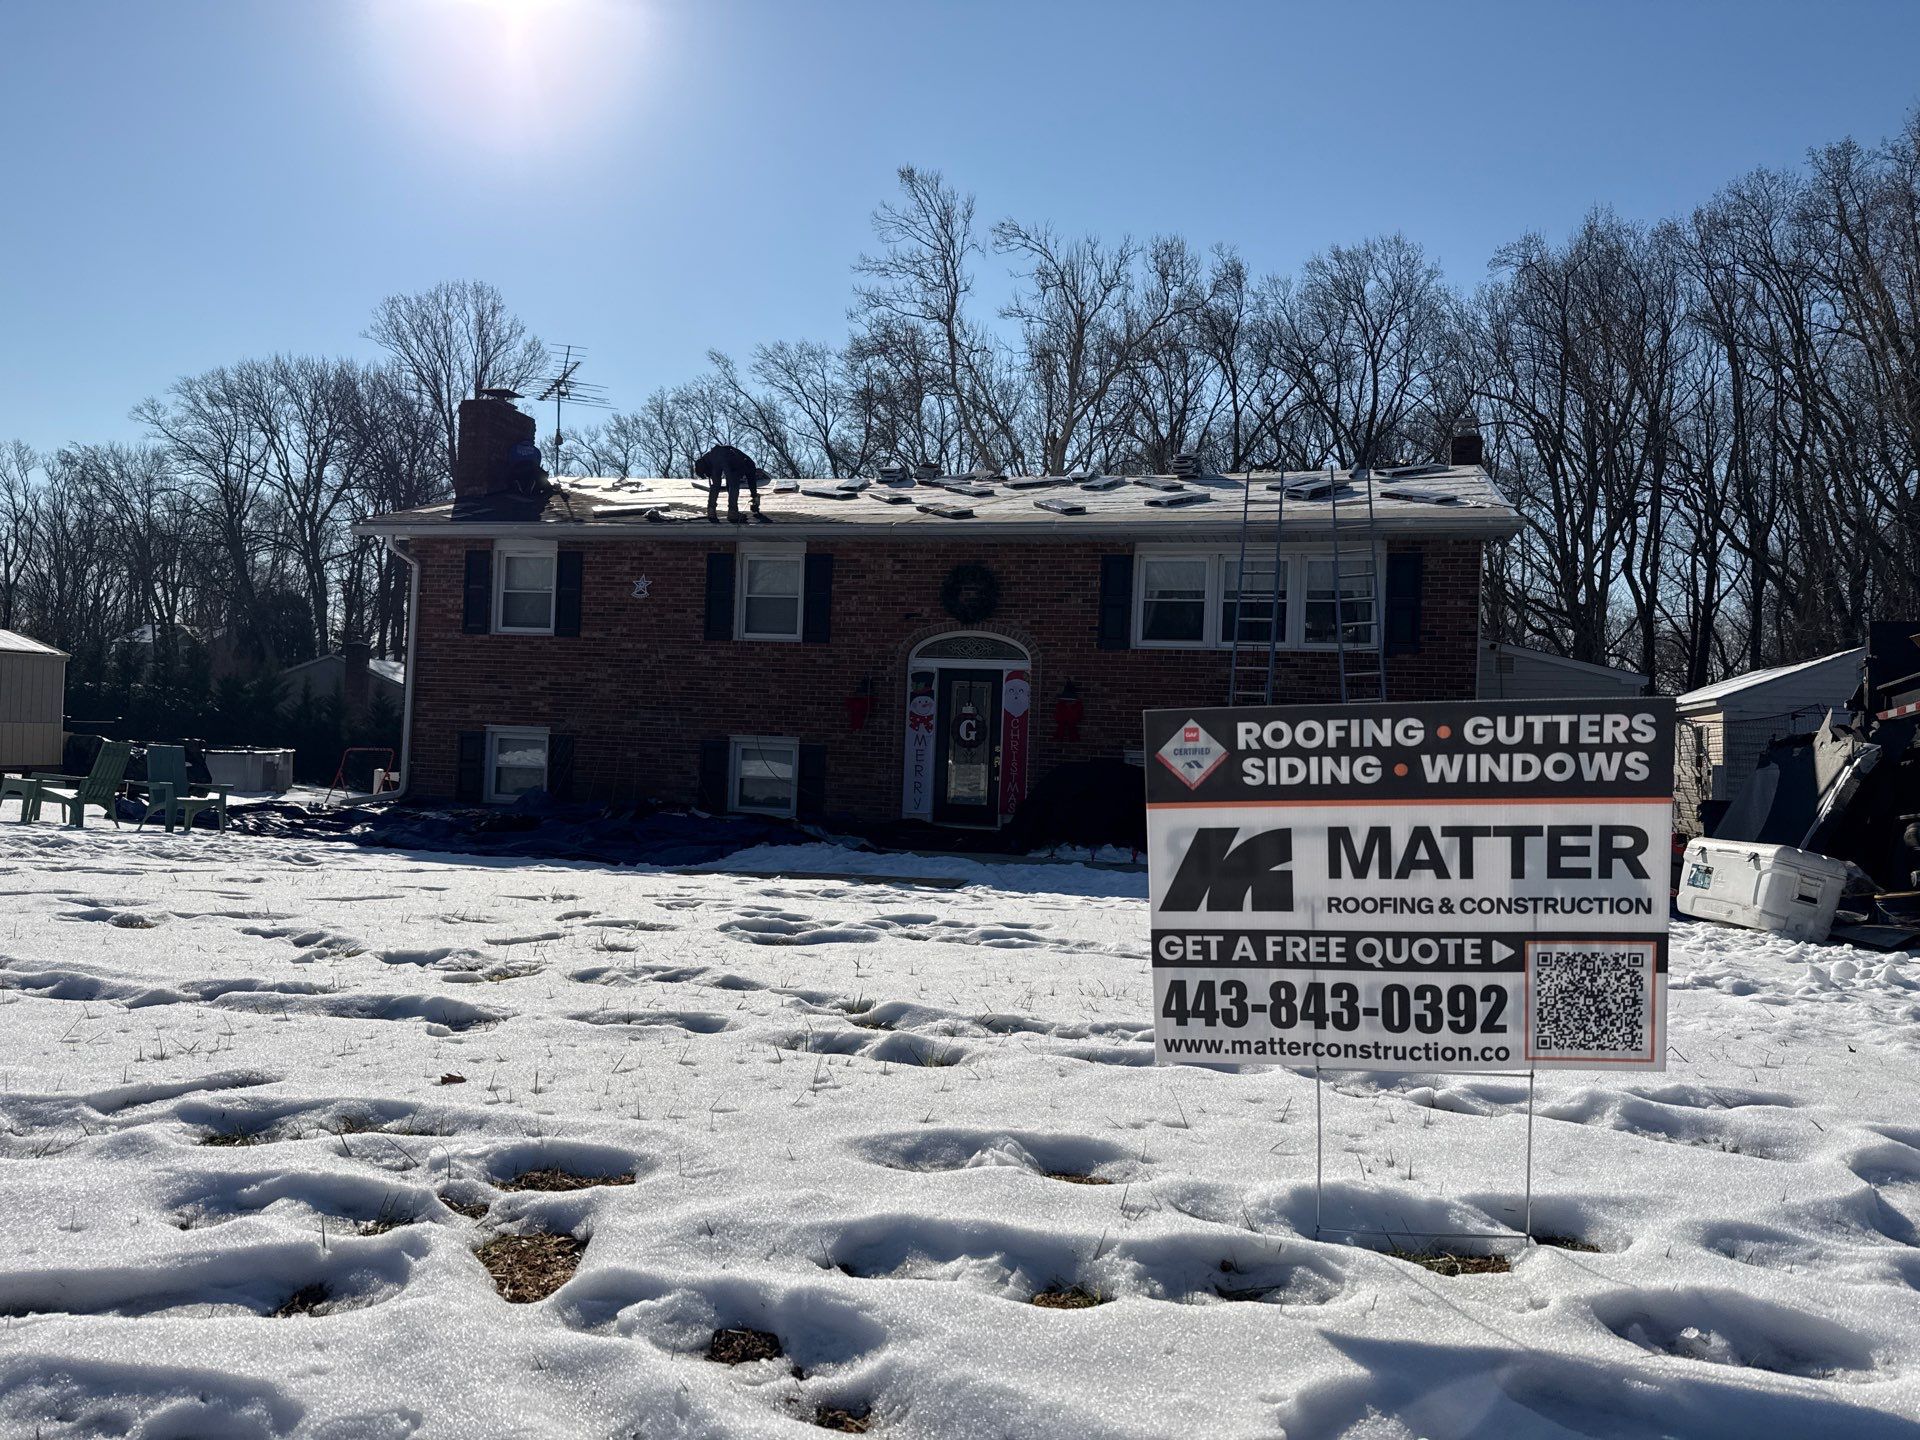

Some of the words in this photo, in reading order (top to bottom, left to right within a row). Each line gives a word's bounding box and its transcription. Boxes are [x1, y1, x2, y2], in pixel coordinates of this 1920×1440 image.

[959, 719, 977, 741] G
[1237, 717, 1425, 750] ROOFING
[1463, 713, 1656, 745] GUTTERS
[1006, 718, 1020, 813] CHRISTMAS
[1173, 747, 1211, 756] CERTIFIED
[1242, 755, 1382, 786] SIDING
[1420, 751, 1649, 783] WINDOWS
[913, 734, 927, 810] MERRY
[1327, 825, 1650, 880] MATTER
[1327, 896, 1434, 915] ROOFING
[1438, 897, 1455, 915] &
[1459, 896, 1653, 915] CONSTRUCTION
[1158, 935, 1224, 962] GET
[1232, 936, 1257, 961] A
[1265, 936, 1347, 963] FREE
[1355, 937, 1482, 968] QUOTE
[1162, 979, 1508, 1035] 443-843-0392
[1163, 1035, 1510, 1063] www.matterconstruction.co
